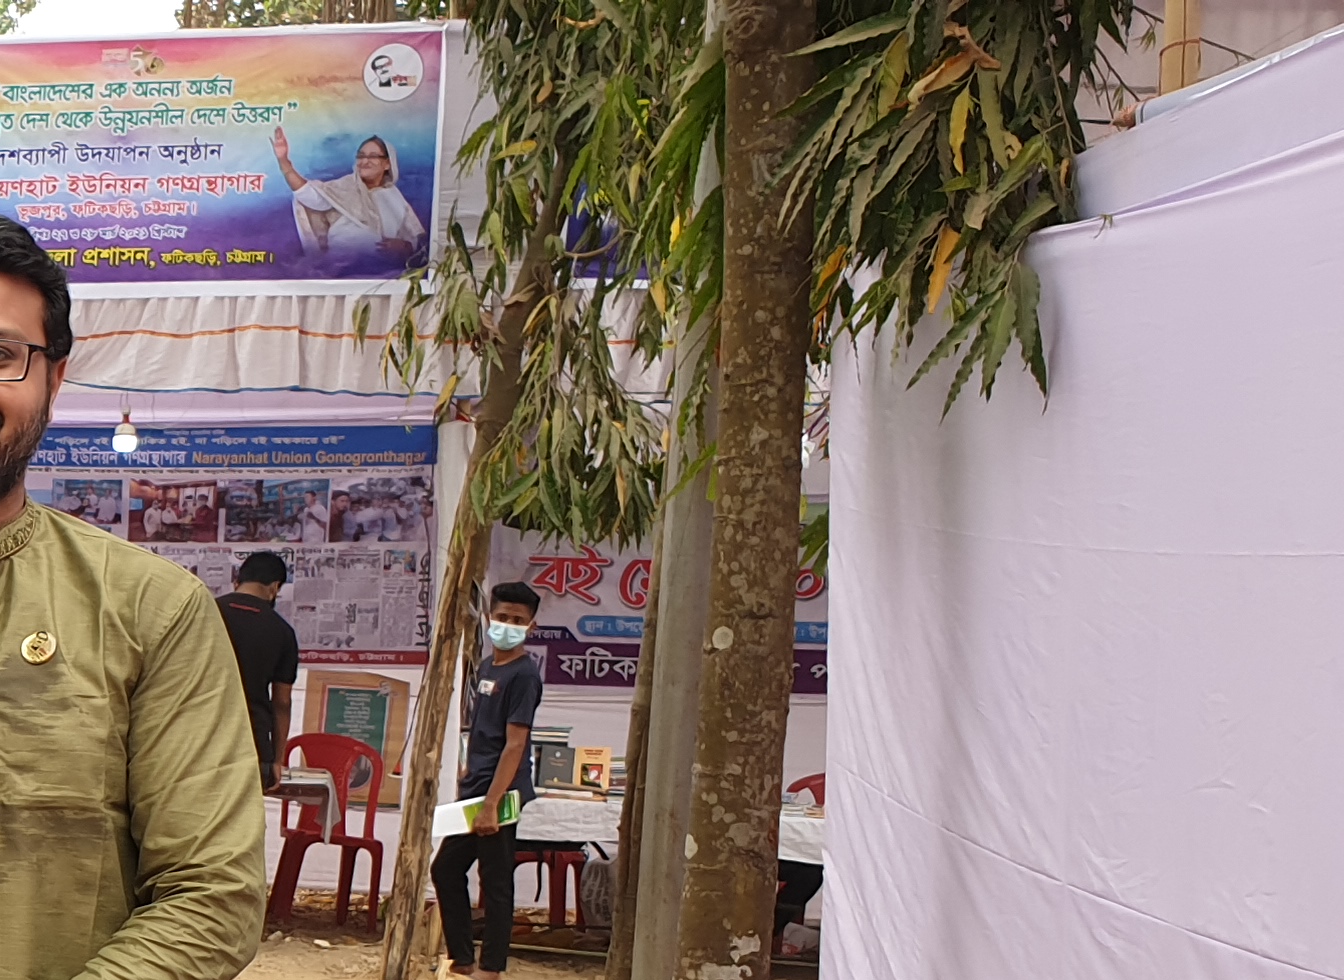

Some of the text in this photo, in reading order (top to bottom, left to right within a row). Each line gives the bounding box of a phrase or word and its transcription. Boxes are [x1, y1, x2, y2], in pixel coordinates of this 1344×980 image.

[99, 74, 233, 100] এক অনন্য অর্জন
[18, 111, 49, 130] দেশ
[54, 109, 94, 130] থেকে
[98, 103, 186, 136] উন্নয়নশীল
[190, 105, 227, 127] দেশে
[74, 140, 152, 165] উদযাপন
[158, 137, 223, 166] অনুষ্ঠান
[67, 172, 149, 197] ইউনিয়ন
[156, 172, 264, 194] গণগ্রন্থাগার
[82, 246, 156, 269] প্রশাসন,
[70, 446, 118, 466] ইউনিয়ন
[192, 450, 427, 468] Narayanhat Union Gonogronthagar
[529, 544, 610, 605] বই
